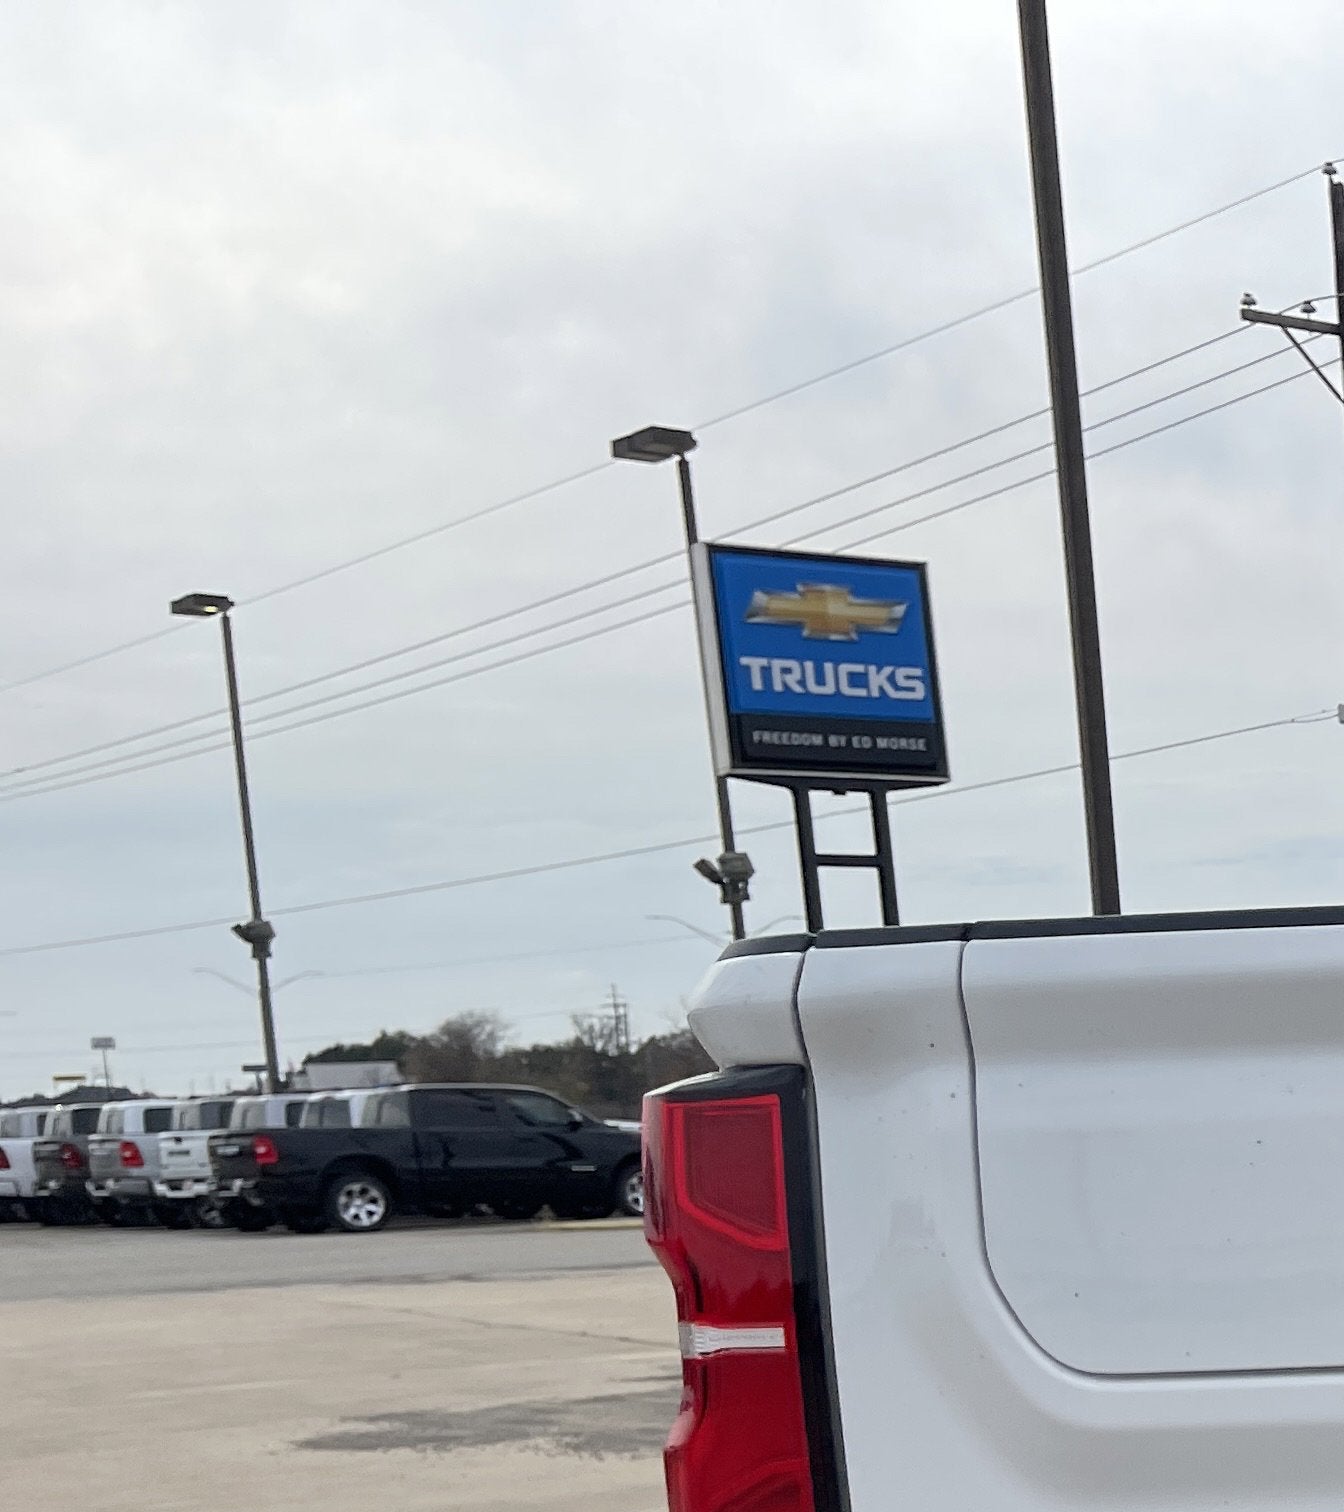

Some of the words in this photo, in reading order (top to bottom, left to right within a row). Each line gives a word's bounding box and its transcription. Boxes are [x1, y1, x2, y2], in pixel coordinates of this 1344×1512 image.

[739, 656, 925, 700] TRUCKS
[752, 730, 823, 746] FREEDOM
[829, 734, 846, 747] BY
[852, 736, 872, 749] ED
[876, 736, 927, 751] MORSE
